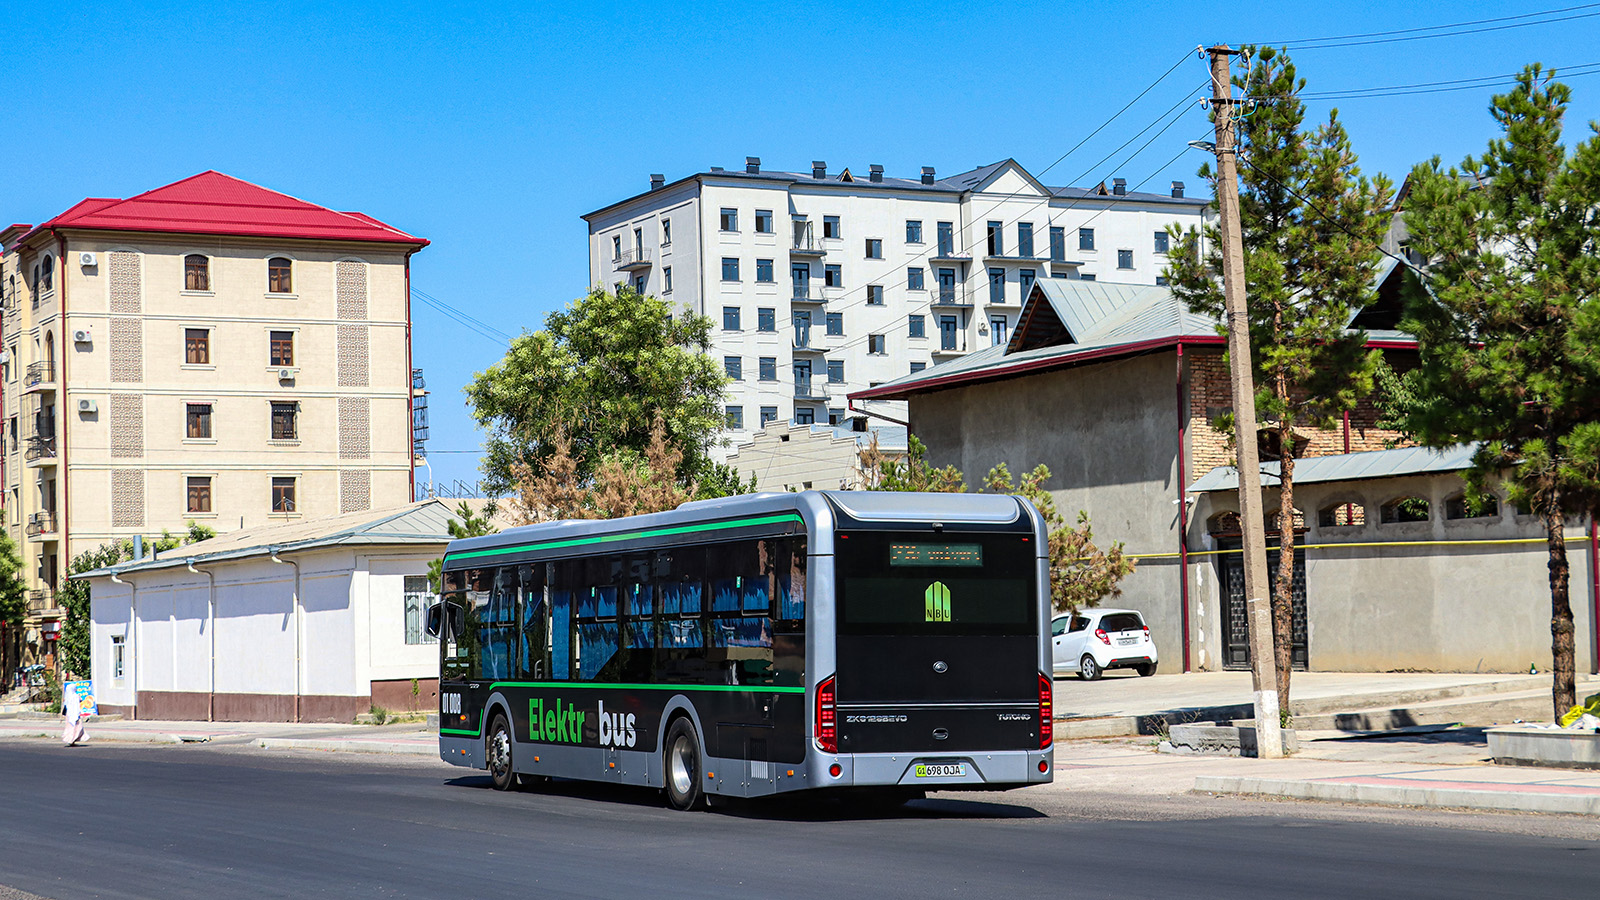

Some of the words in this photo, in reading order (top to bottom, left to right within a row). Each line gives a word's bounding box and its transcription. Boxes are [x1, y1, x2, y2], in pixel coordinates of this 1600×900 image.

[926, 609, 950, 619] NBU
[529, 698, 585, 744] Elektr
[598, 700, 637, 748] bus
[926, 765, 942, 776] 698
[943, 765, 961, 776] OJA
